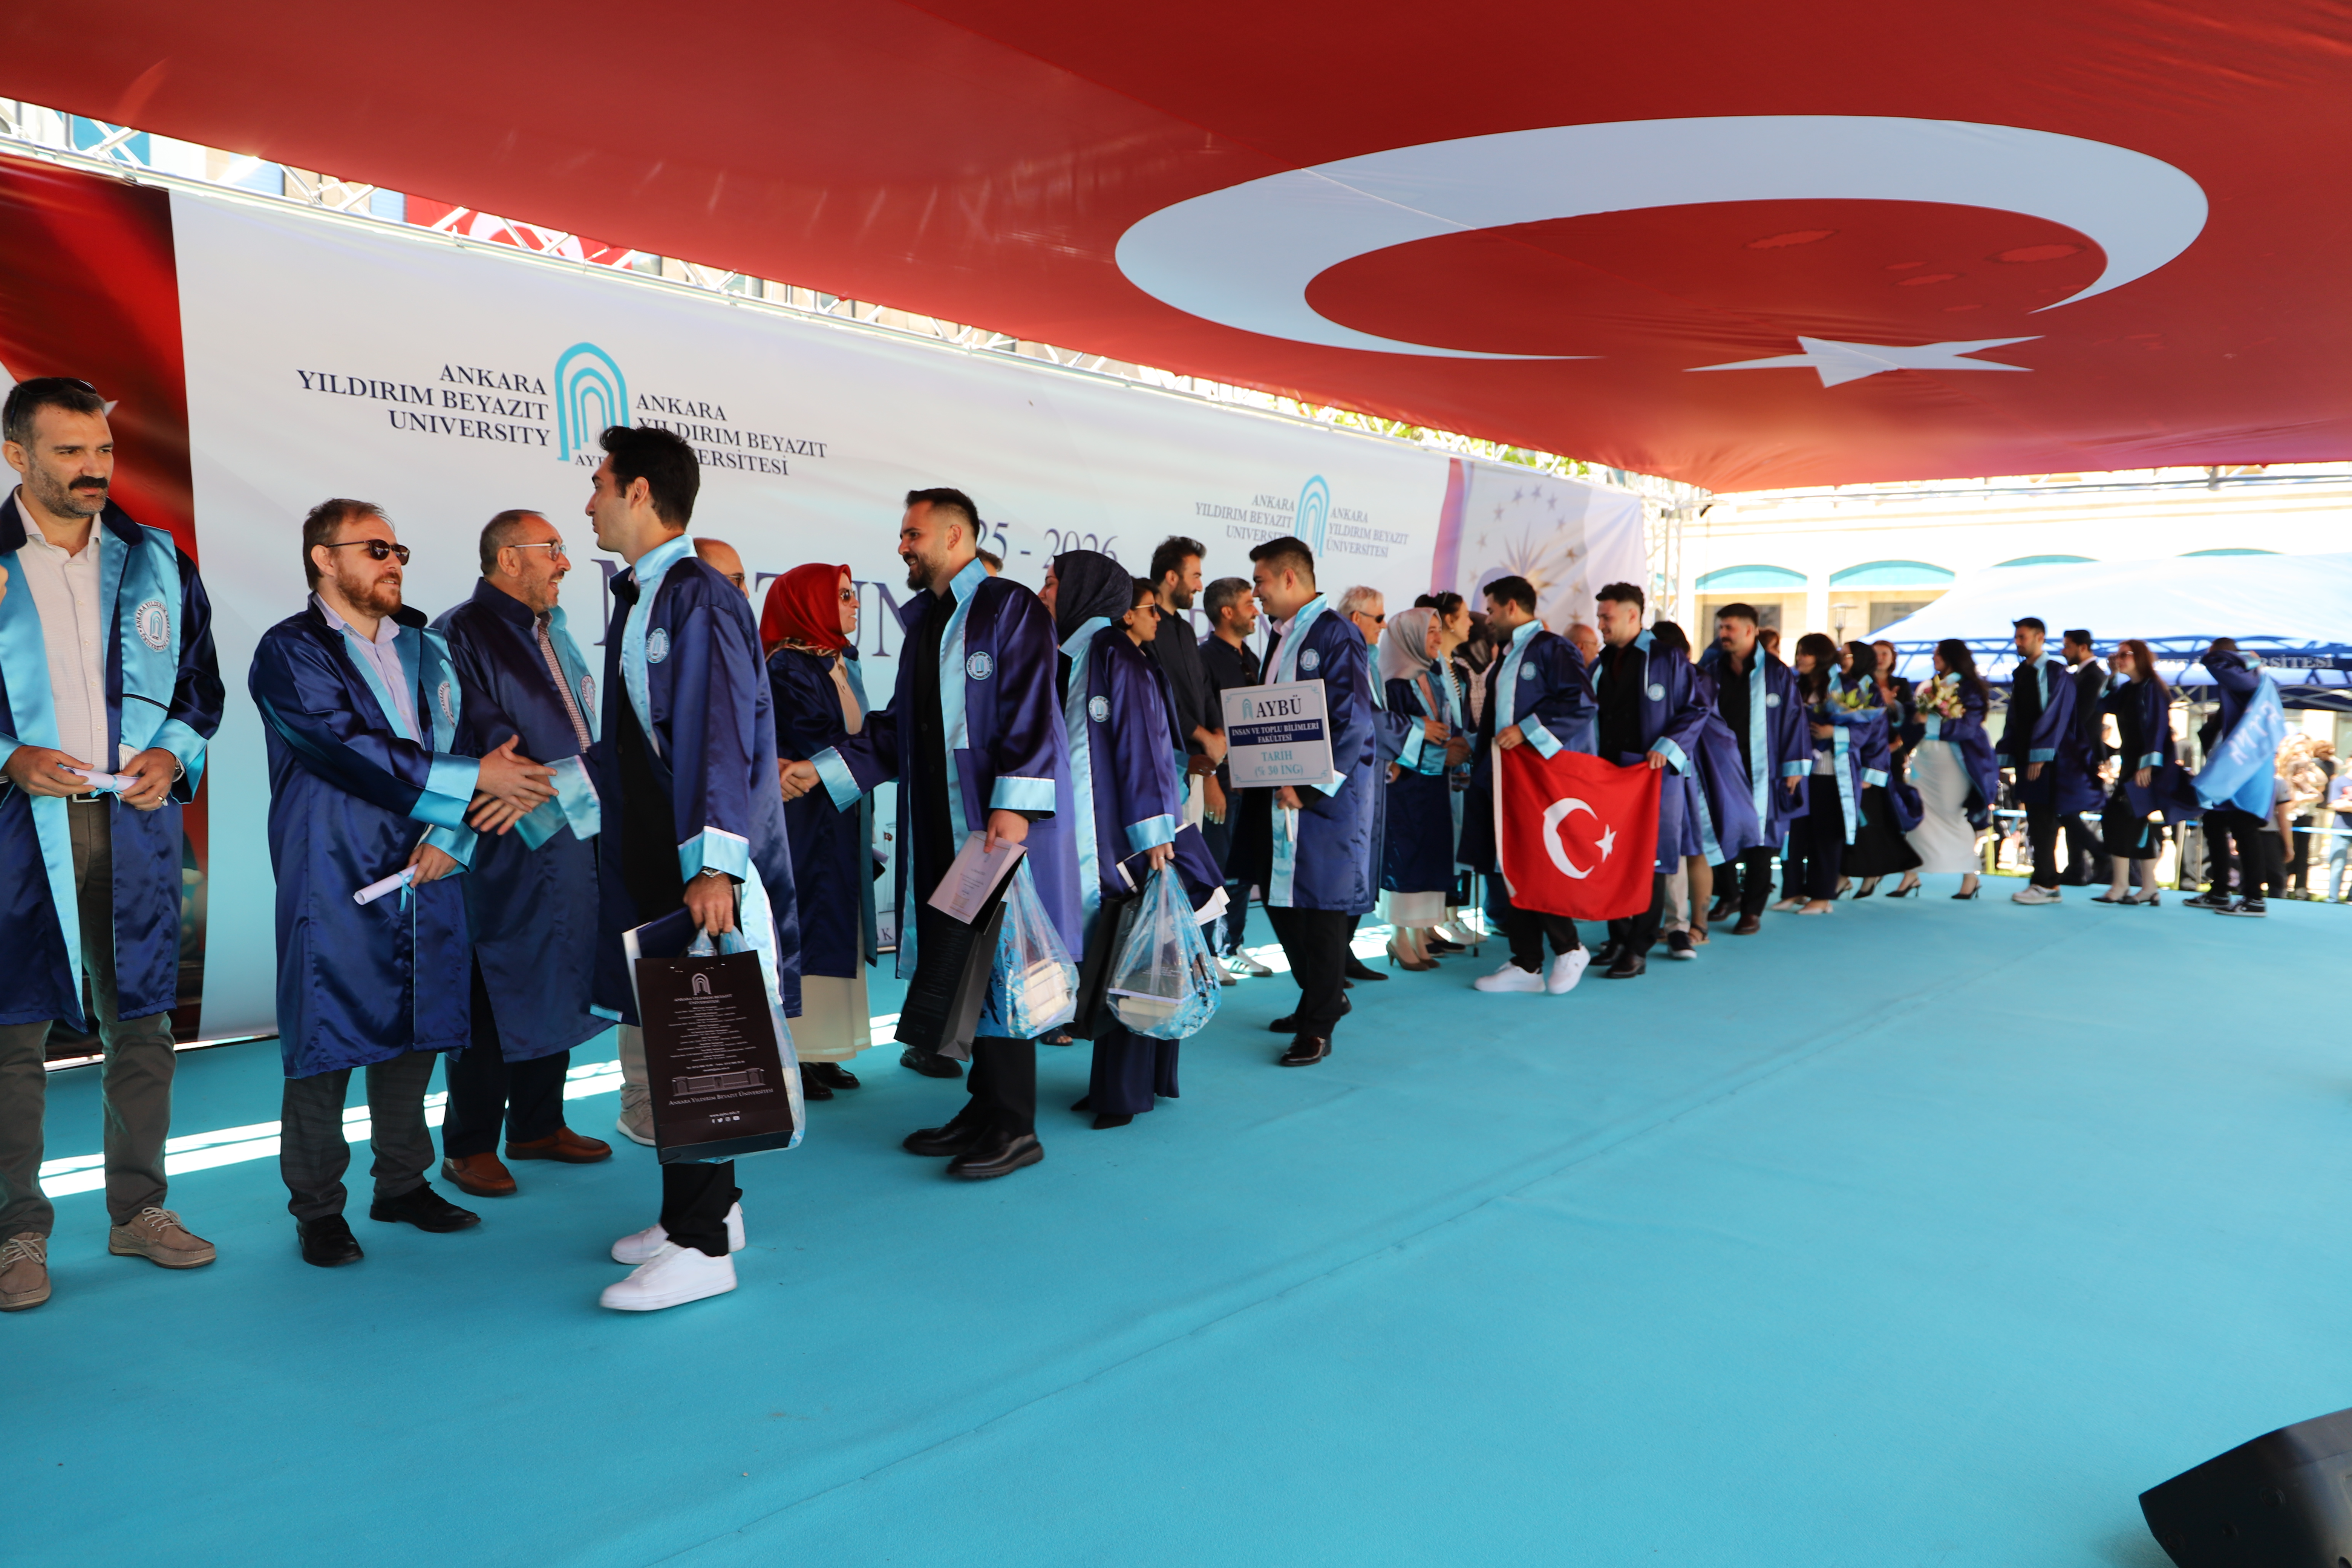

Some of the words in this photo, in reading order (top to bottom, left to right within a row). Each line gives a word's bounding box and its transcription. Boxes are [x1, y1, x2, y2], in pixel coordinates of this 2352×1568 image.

[439, 363, 547, 396] ANKARA
[296, 369, 434, 406] YILDIRIM
[441, 389, 549, 421] BEYAZIT
[636, 393, 727, 421] ANKARA
[387, 409, 551, 447] UNIVERSITY
[747, 432, 828, 458] BEYAZIT
[696, 448, 790, 476] ERSİTESİ
[1252, 494, 1295, 512] ANKARA
[1195, 502, 1247, 522] YILDIRIM
[1250, 510, 1294, 528] BEYAZIT
[1330, 507, 1368, 523] ANKARA
[1329, 522, 1371, 540] YILDIRIM
[1373, 528, 1409, 545] BEYAZIT
[1326, 536, 1389, 558] ÜNİVERSİTESİ
[136, 605, 146, 628] ANKARA
[1257, 695, 1302, 718] AYBÜ
[1232, 727, 1250, 736] İNSAN
[1284, 721, 1319, 732] BİLİMLERİ
[1258, 733, 1292, 743] FAKÜLTESİ
[1261, 748, 1292, 761] TARİH
[1268, 765, 1278, 775] 30
